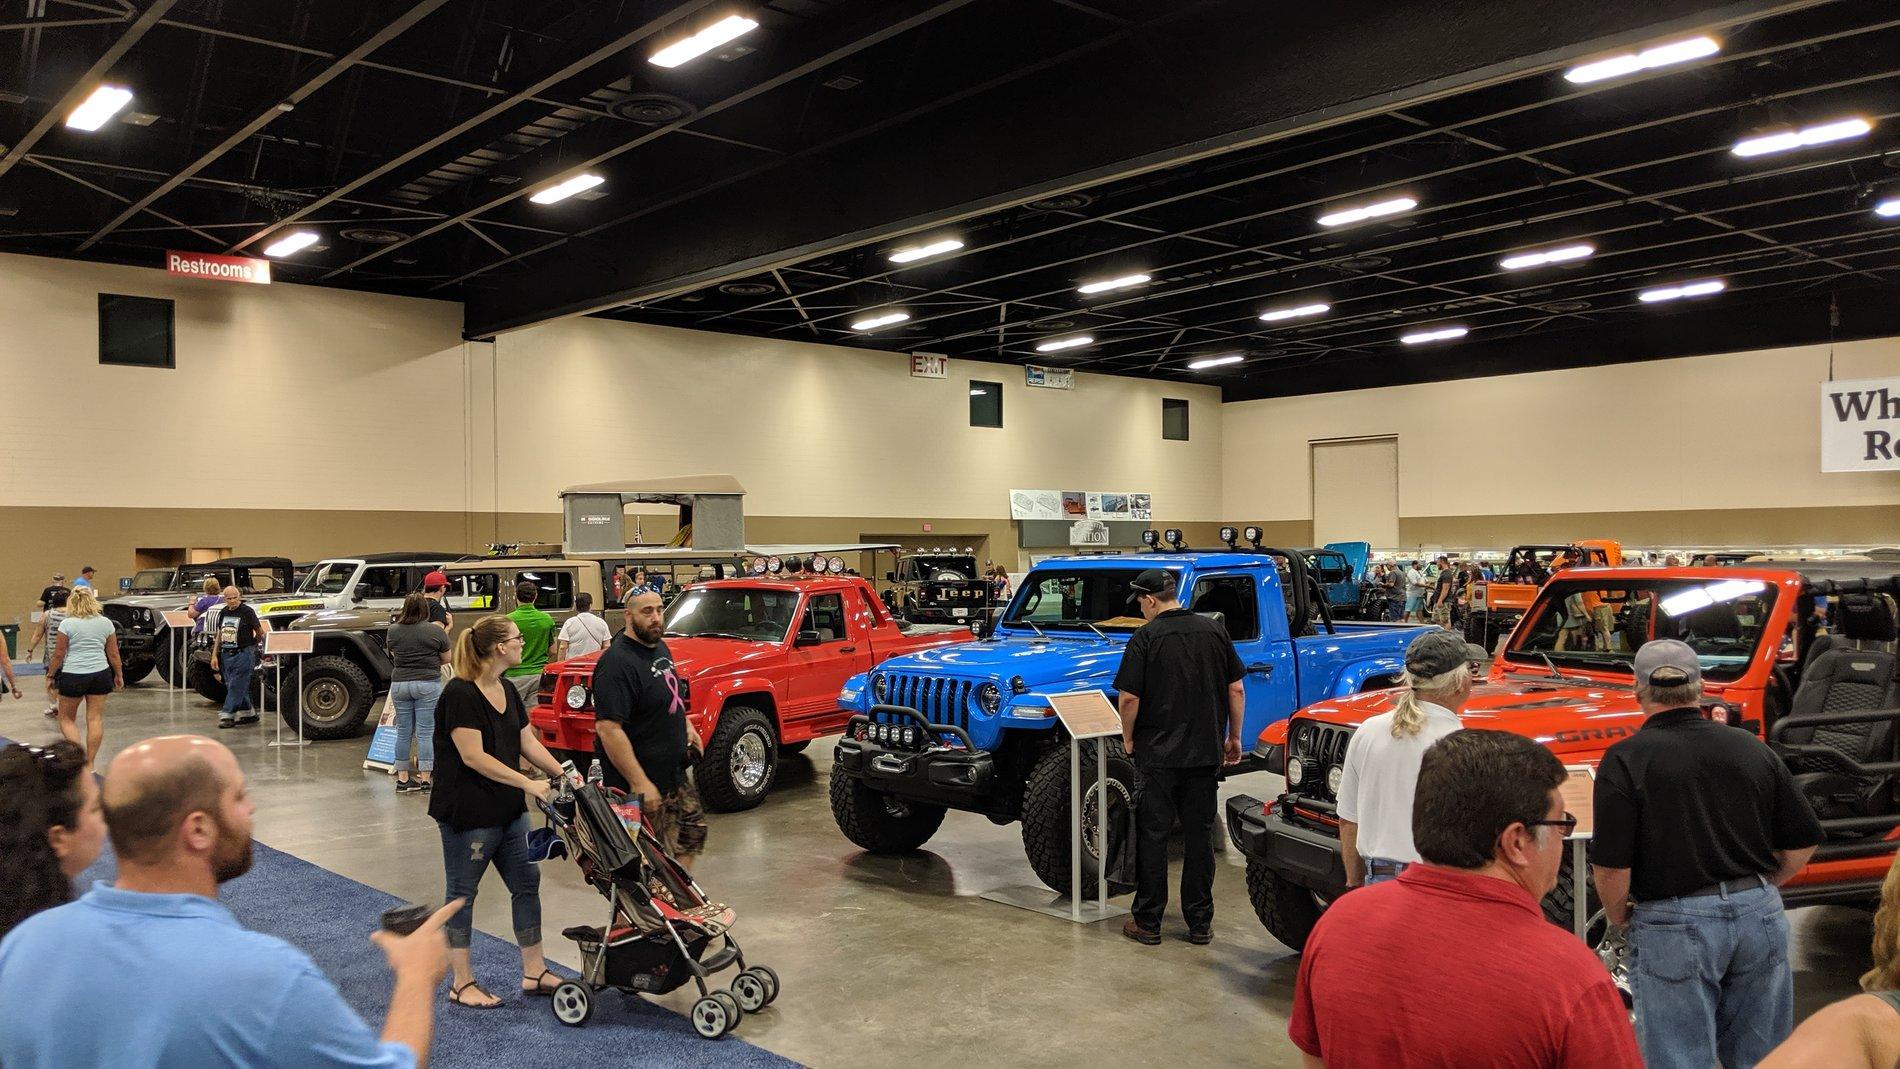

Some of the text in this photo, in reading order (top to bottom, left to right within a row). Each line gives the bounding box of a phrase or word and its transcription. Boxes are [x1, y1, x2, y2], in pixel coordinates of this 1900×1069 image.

[170, 254, 252, 279] Restrooms
[912, 355, 947, 375] EXIT
[936, 587, 984, 600] Jeep
